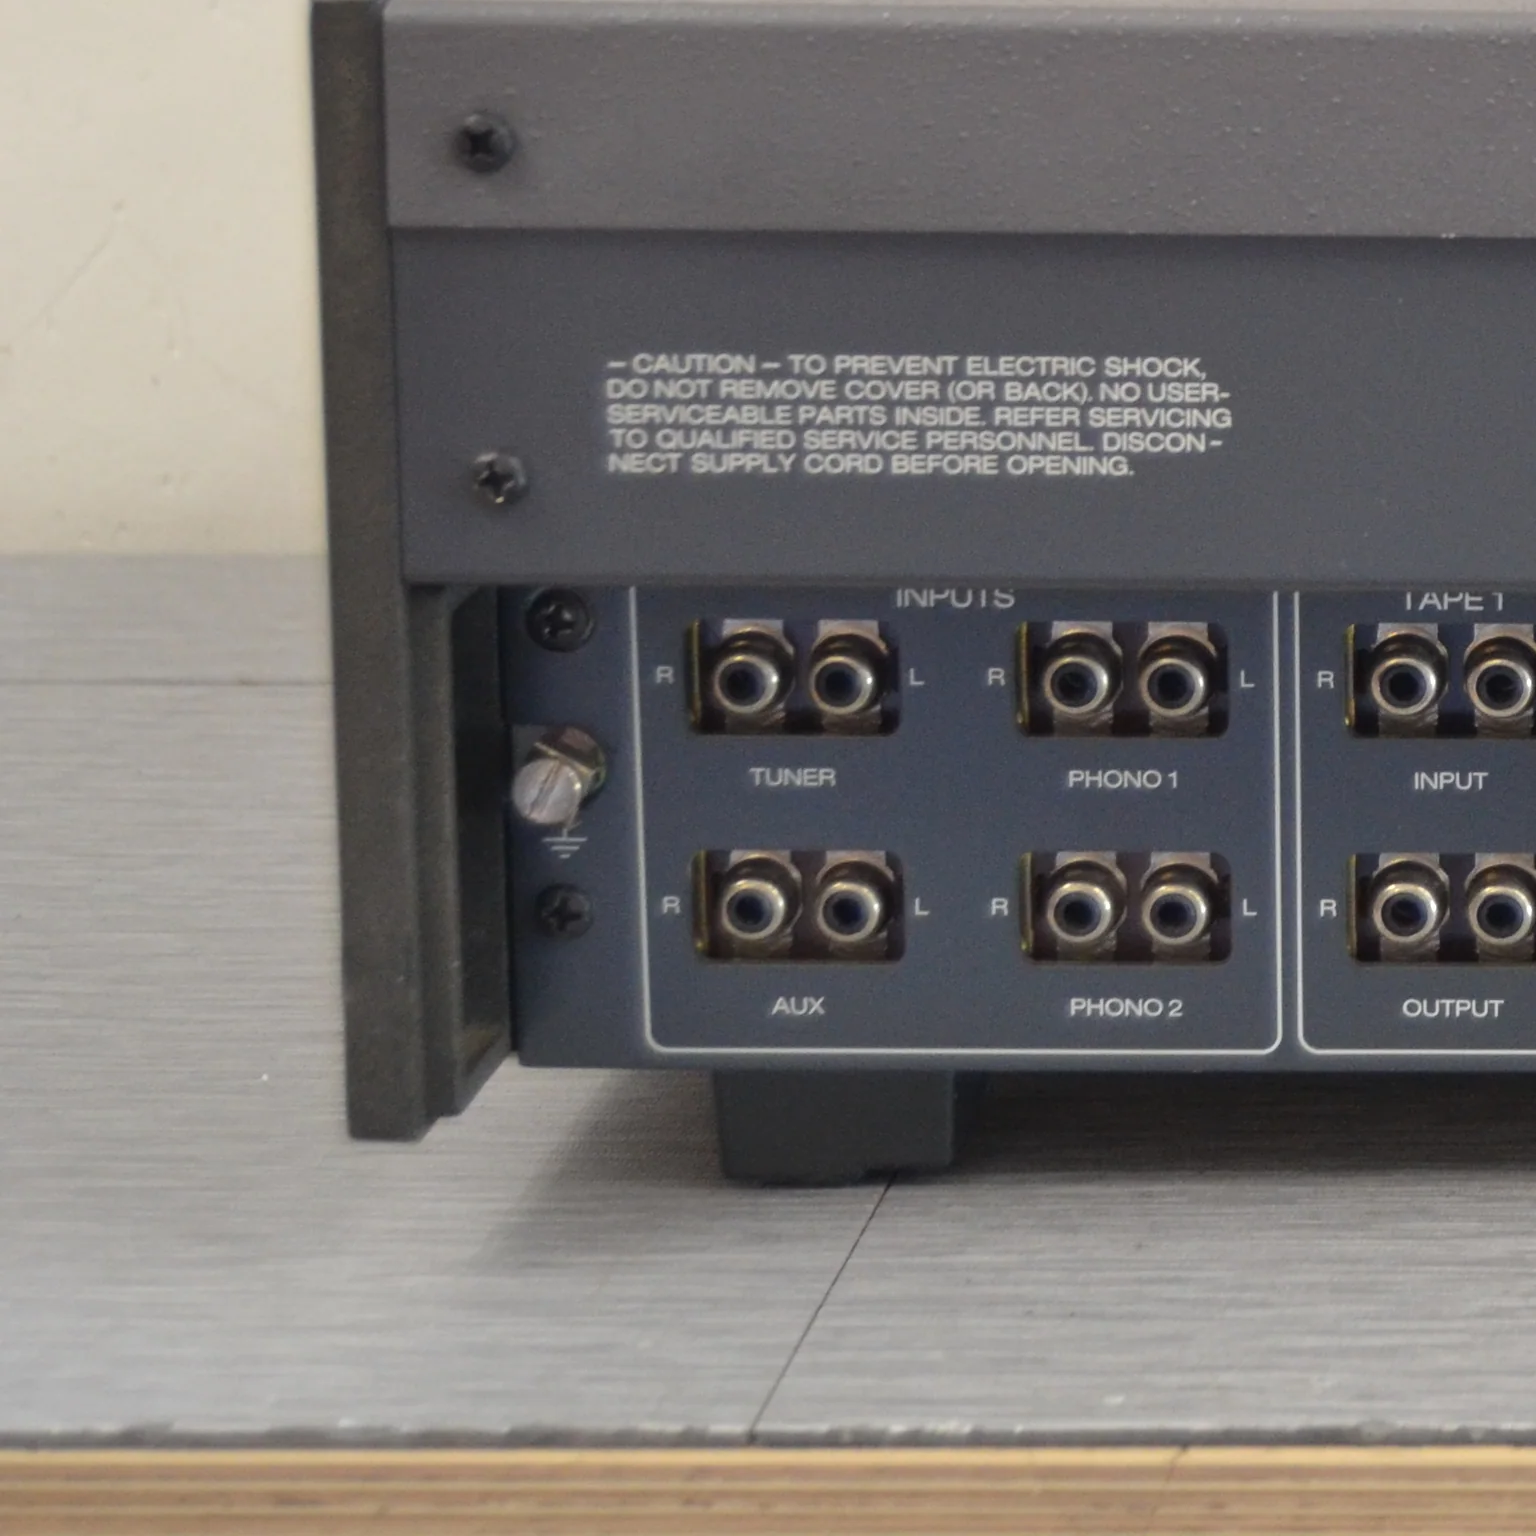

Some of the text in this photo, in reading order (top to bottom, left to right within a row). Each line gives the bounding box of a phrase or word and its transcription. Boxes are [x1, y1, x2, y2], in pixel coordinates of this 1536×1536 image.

[632, 353, 755, 374] CAUTION
[788, 354, 827, 375] TO
[833, 355, 959, 376] PREVENT
[966, 356, 1096, 377] ELECTRIC
[1104, 356, 1206, 380] SHOCK,
[607, 378, 1229, 404] DO NOT REMOVE COVER (OR BACK). NO USER-
[607, 404, 1232, 428] SERVICEABLE PARTS INSIDE. REFER SERVICING
[609, 428, 648, 449] TO
[655, 429, 796, 449] QUALIFIED
[803, 429, 917, 450] SERVICE
[926, 431, 1094, 451] PERSONNEL.
[608, 452, 1134, 476] NECT SUPPLY CORD BEFORE OPENING.
[655, 666, 673, 683] R
[909, 668, 924, 686] L
[988, 668, 1005, 686] R
[1240, 670, 1254, 688] L
[1317, 671, 1334, 688] R
[749, 768, 836, 787] TUNER
[1068, 770, 1177, 788] PHONO 1
[1415, 772, 1488, 790] INPUT
[662, 896, 680, 914] R
[915, 898, 929, 915] L
[991, 898, 1008, 916] R
[1243, 899, 1257, 916] L
[1320, 899, 1336, 917] R
[772, 997, 824, 1015] AUX
[1070, 998, 1182, 1017] PHONO 2
[1402, 999, 1504, 1018] OUTPUT
